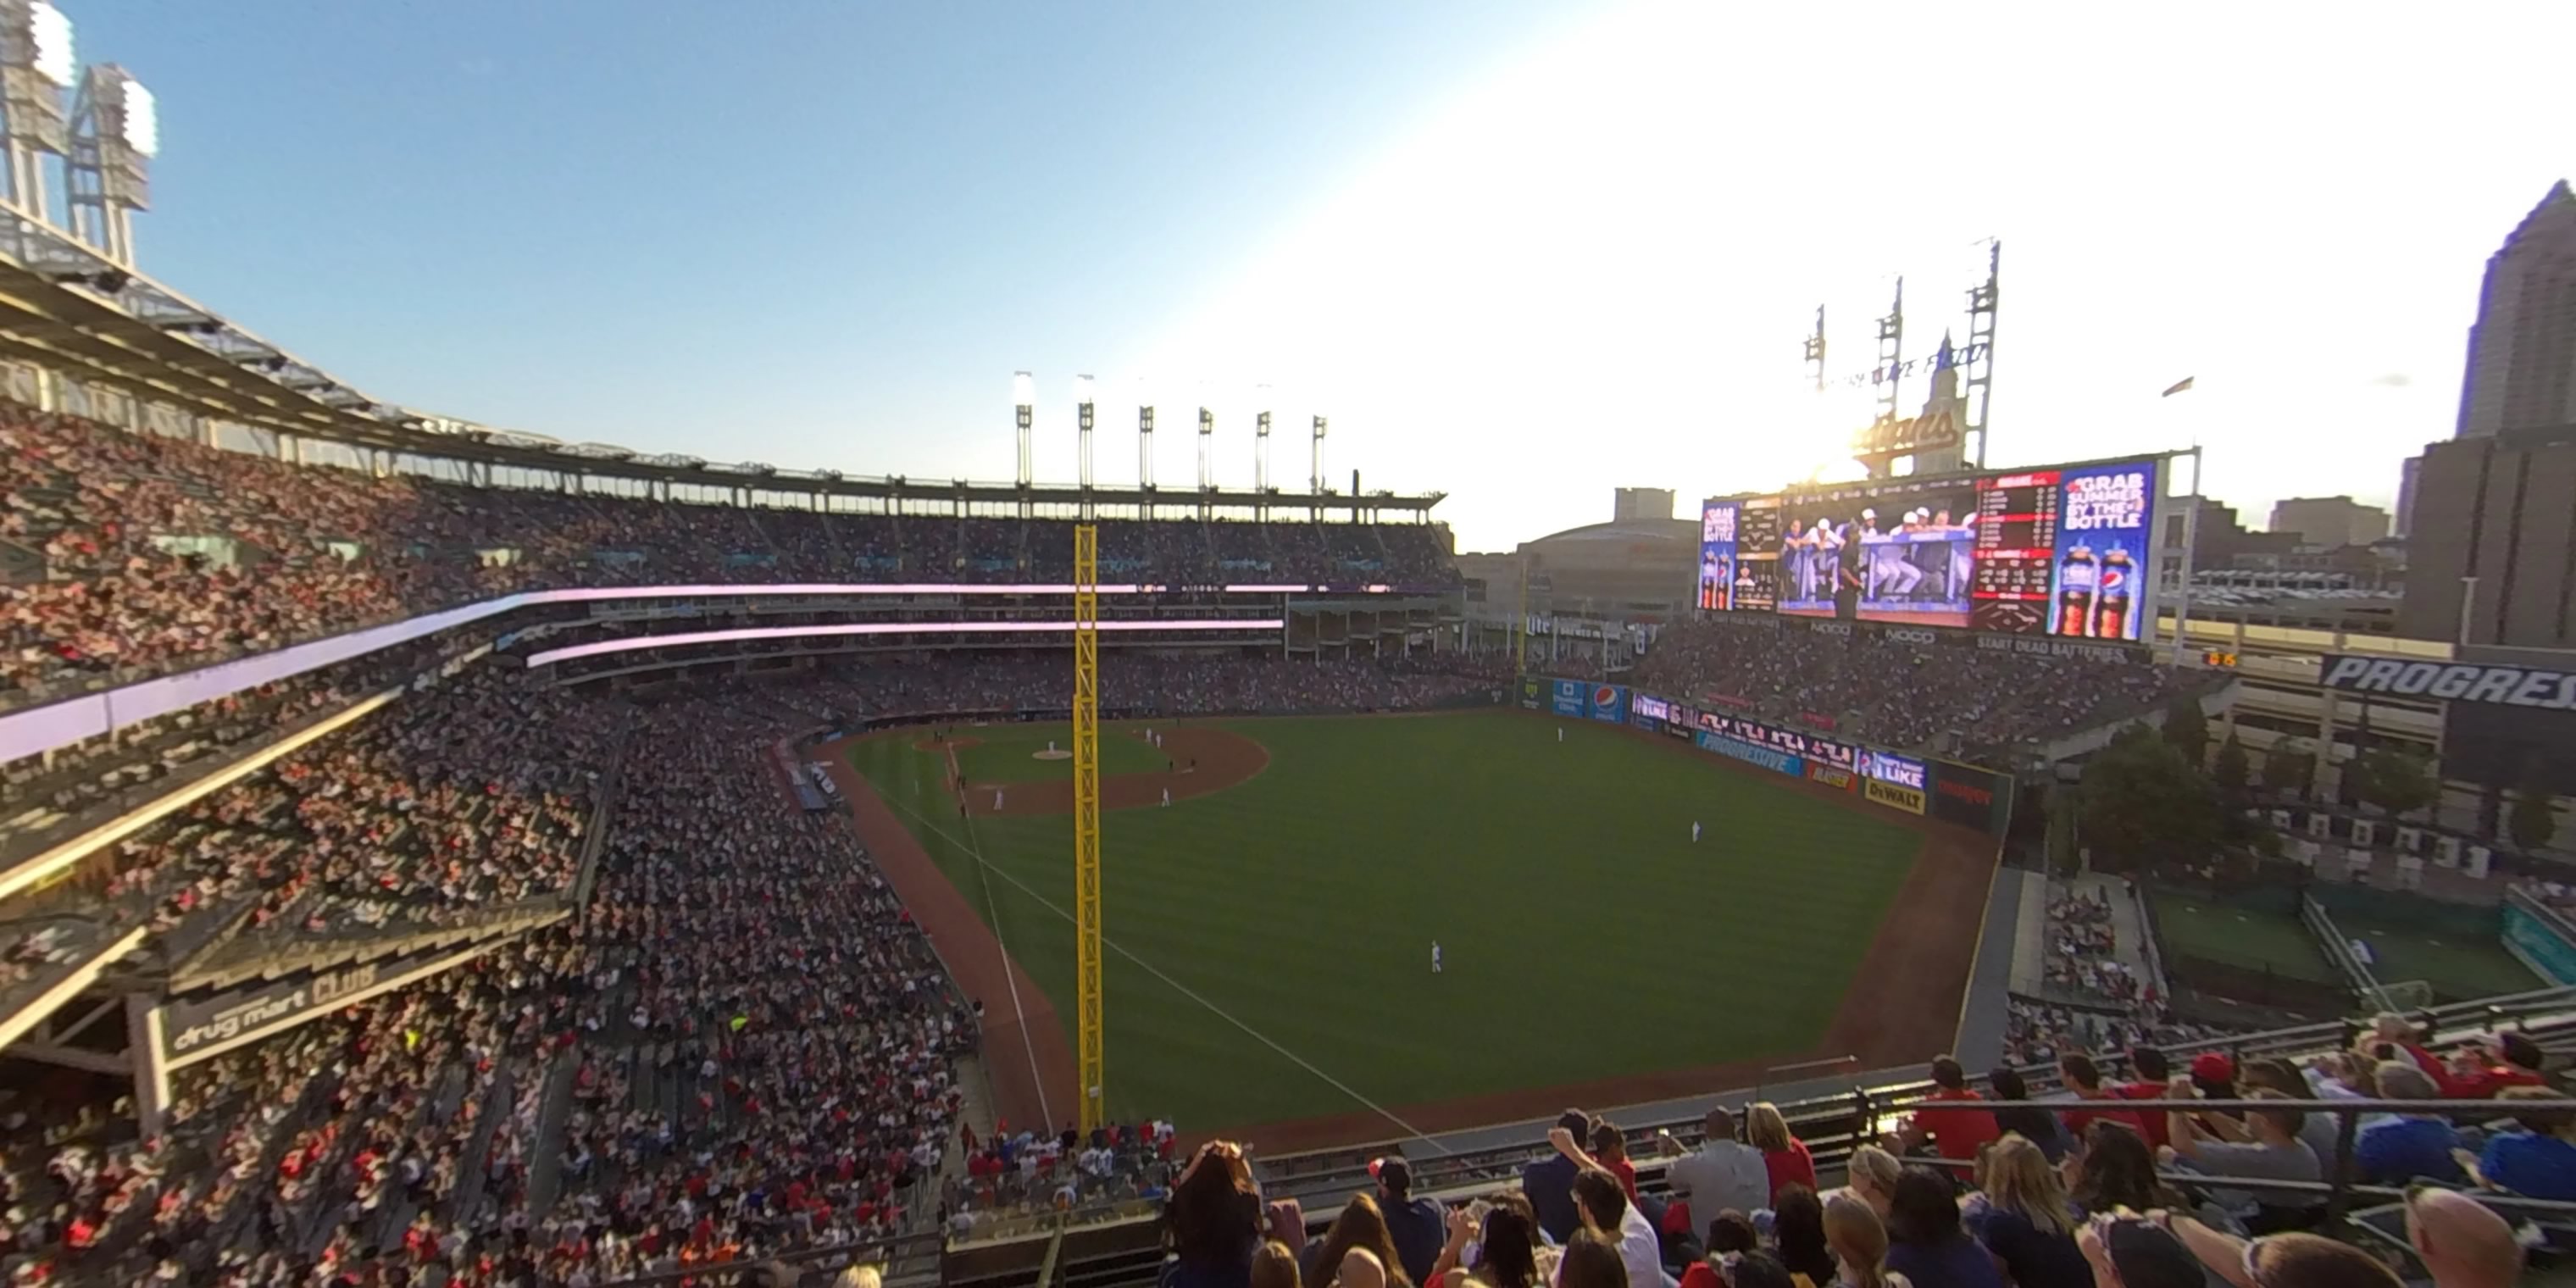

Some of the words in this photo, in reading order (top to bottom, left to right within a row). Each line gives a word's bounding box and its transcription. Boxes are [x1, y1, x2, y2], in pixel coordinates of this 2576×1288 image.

[2075, 473, 2144, 492] GRAB
[2068, 489, 2144, 504] SUMMER
[2067, 502, 2089, 516] BY
[2065, 513, 2142, 530] BOTTLE
[1885, 629, 1935, 644] NOCO
[1977, 636, 2013, 650] START
[2015, 640, 2050, 655] DEAD
[1703, 733, 1790, 773] PROGRESSIVE
[174, 1016, 241, 1051] drug
[243, 989, 307, 1027] mart
